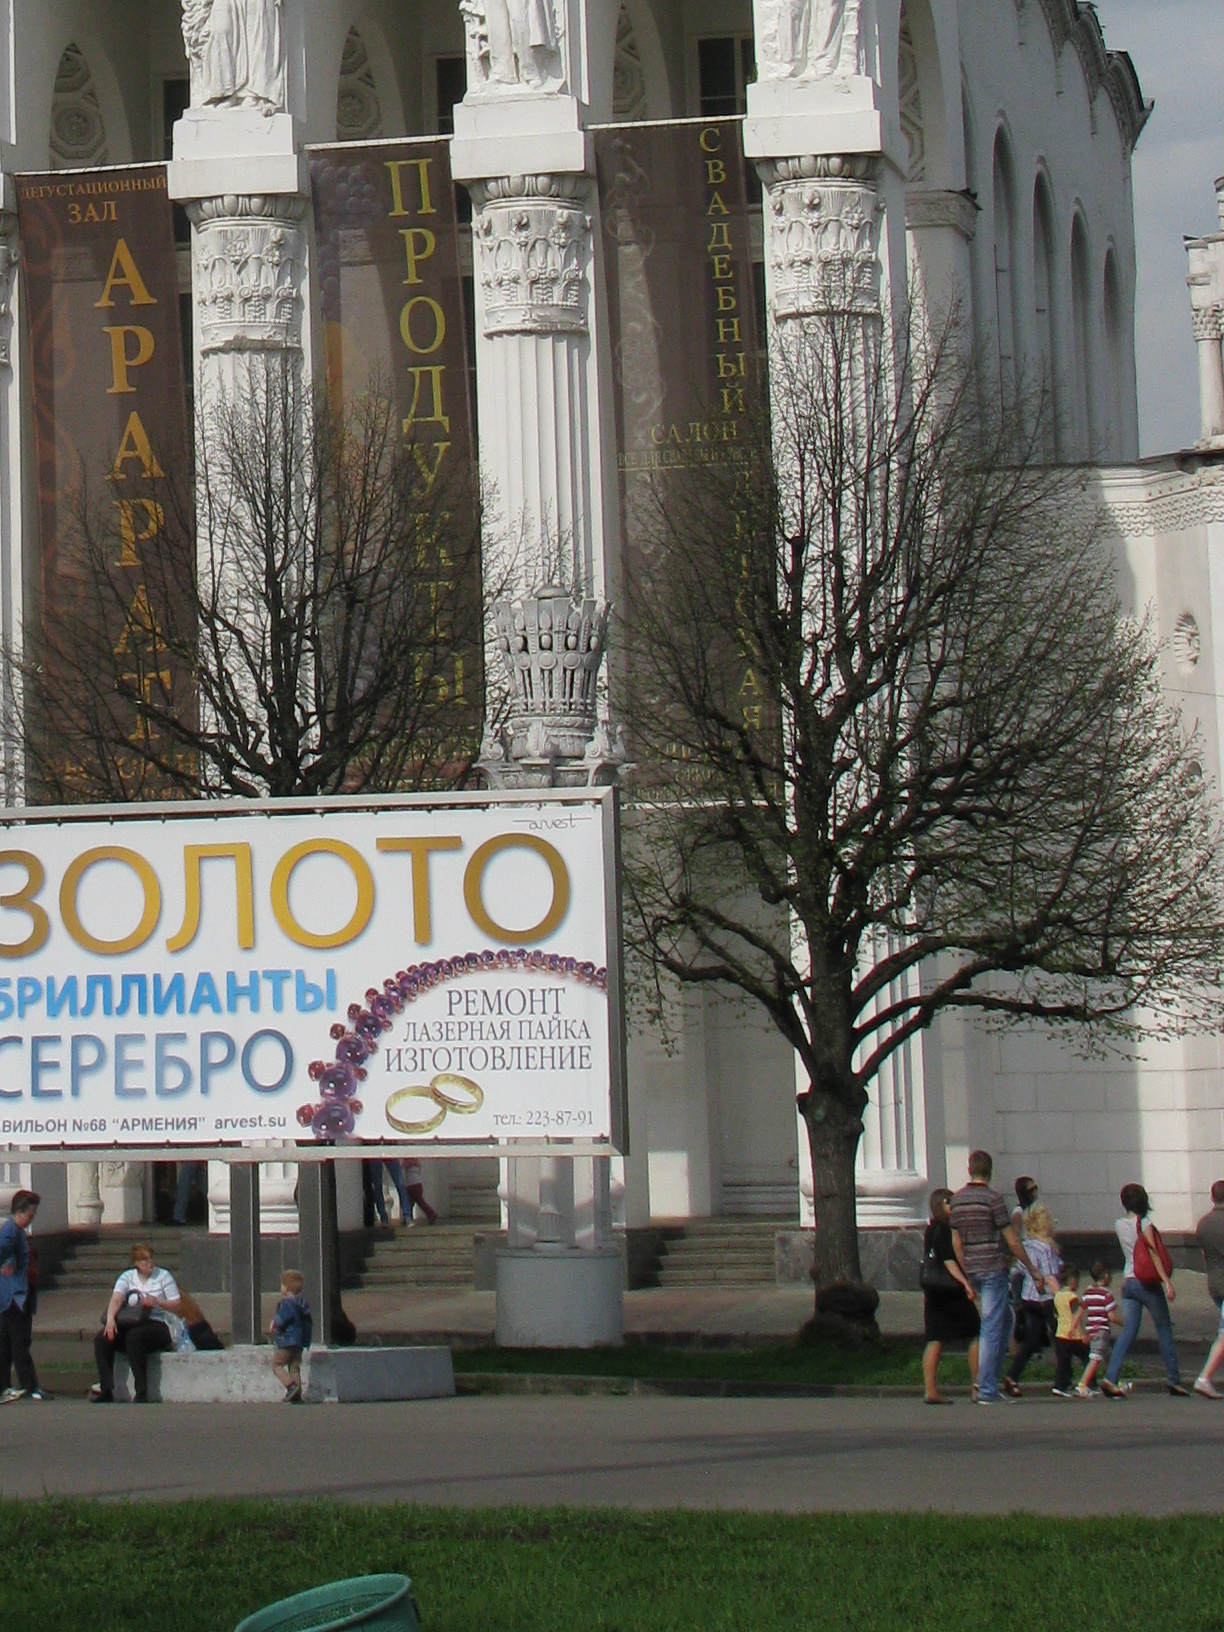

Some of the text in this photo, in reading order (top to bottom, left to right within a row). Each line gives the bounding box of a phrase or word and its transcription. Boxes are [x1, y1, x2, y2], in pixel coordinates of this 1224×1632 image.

[20, 175, 167, 200] ДЕГУСТАЦИОННЫЙ
[67, 201, 118, 224] ЗАЛ
[698, 127, 745, 414] СВАДЕБНЫЙ
[387, 158, 468, 706] ПРОДУКТЫ
[650, 421, 738, 445] САЛОН
[94, 237, 172, 741] АРАРАТ
[446, 987, 566, 1016] РЕМОНТ
[403, 1014, 592, 1042] ЛАЗЕРНАЯ ПАЙКА
[385, 1045, 593, 1073] ИЗГОТОВЛЕНИЕ
[72, 1118, 107, 1132] №68
[214, 1114, 287, 1129] arvest.su
[492, 1110, 594, 1127] тел.: 223-87-91
